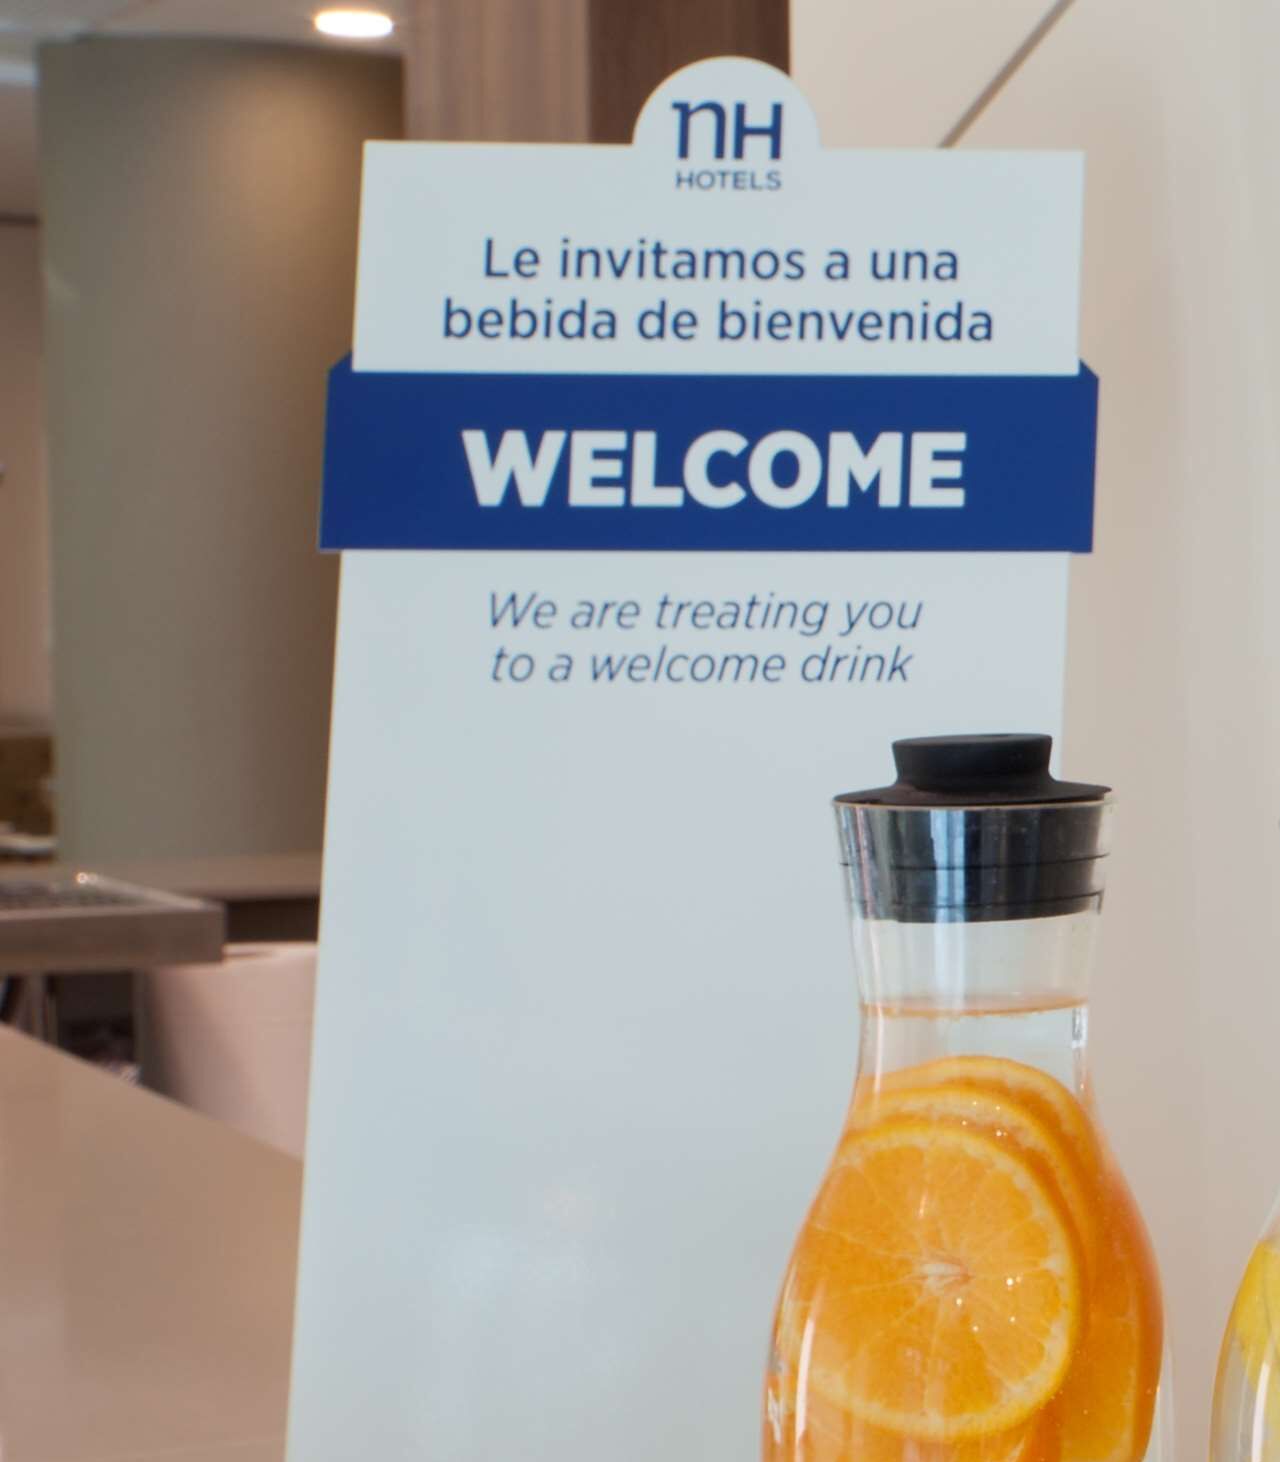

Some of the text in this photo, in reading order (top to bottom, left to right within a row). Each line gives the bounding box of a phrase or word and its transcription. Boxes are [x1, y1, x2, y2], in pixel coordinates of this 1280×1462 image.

[675, 169, 783, 191] HOTELS
[483, 237, 959, 282] Le invitamos a una
[442, 297, 993, 343] bebida de bienvenida
[462, 429, 967, 509] WELCOME
[489, 592, 923, 637] We are treating you
[491, 645, 913, 683] to a welcome drink
